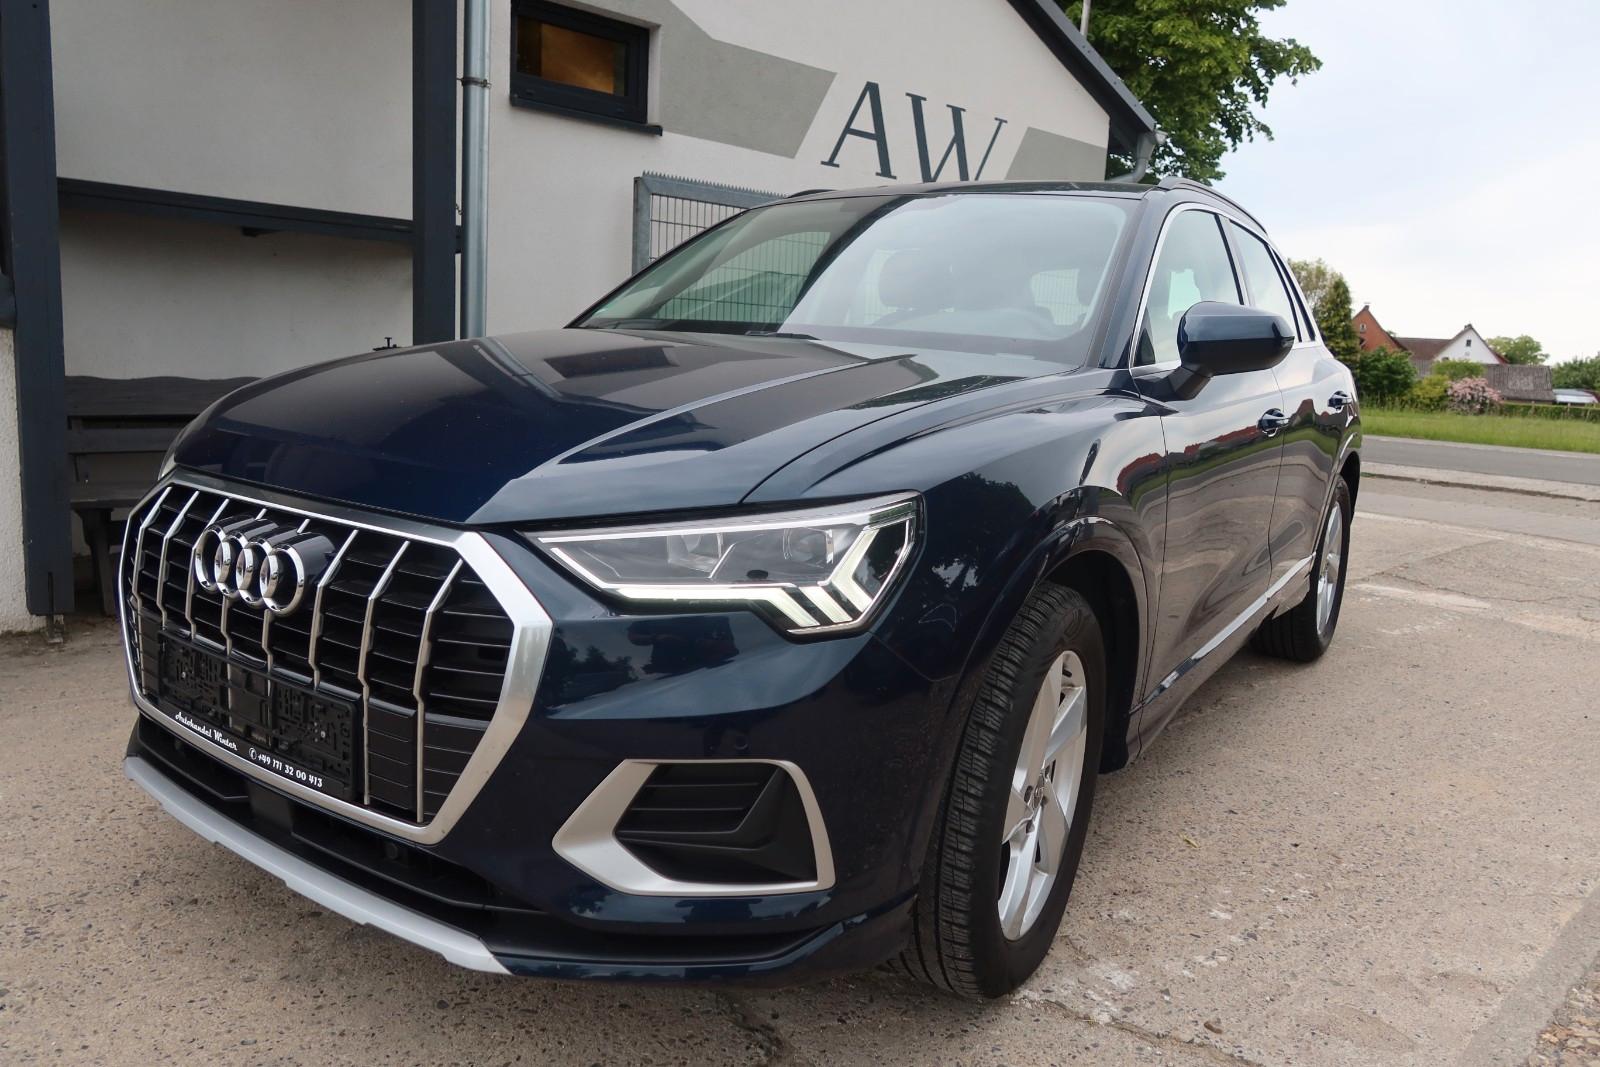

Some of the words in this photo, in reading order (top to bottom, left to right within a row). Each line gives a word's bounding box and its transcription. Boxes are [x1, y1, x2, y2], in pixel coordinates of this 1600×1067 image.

[820, 81, 1008, 183] AW
[175, 711, 213, 738] Autohandel
[213, 729, 238, 751] Winter
[258, 753, 271, 765] +49
[272, 759, 283, 771] 171
[284, 764, 294, 776] 32
[296, 770, 307, 781] 00
[308, 774, 323, 788] 413
